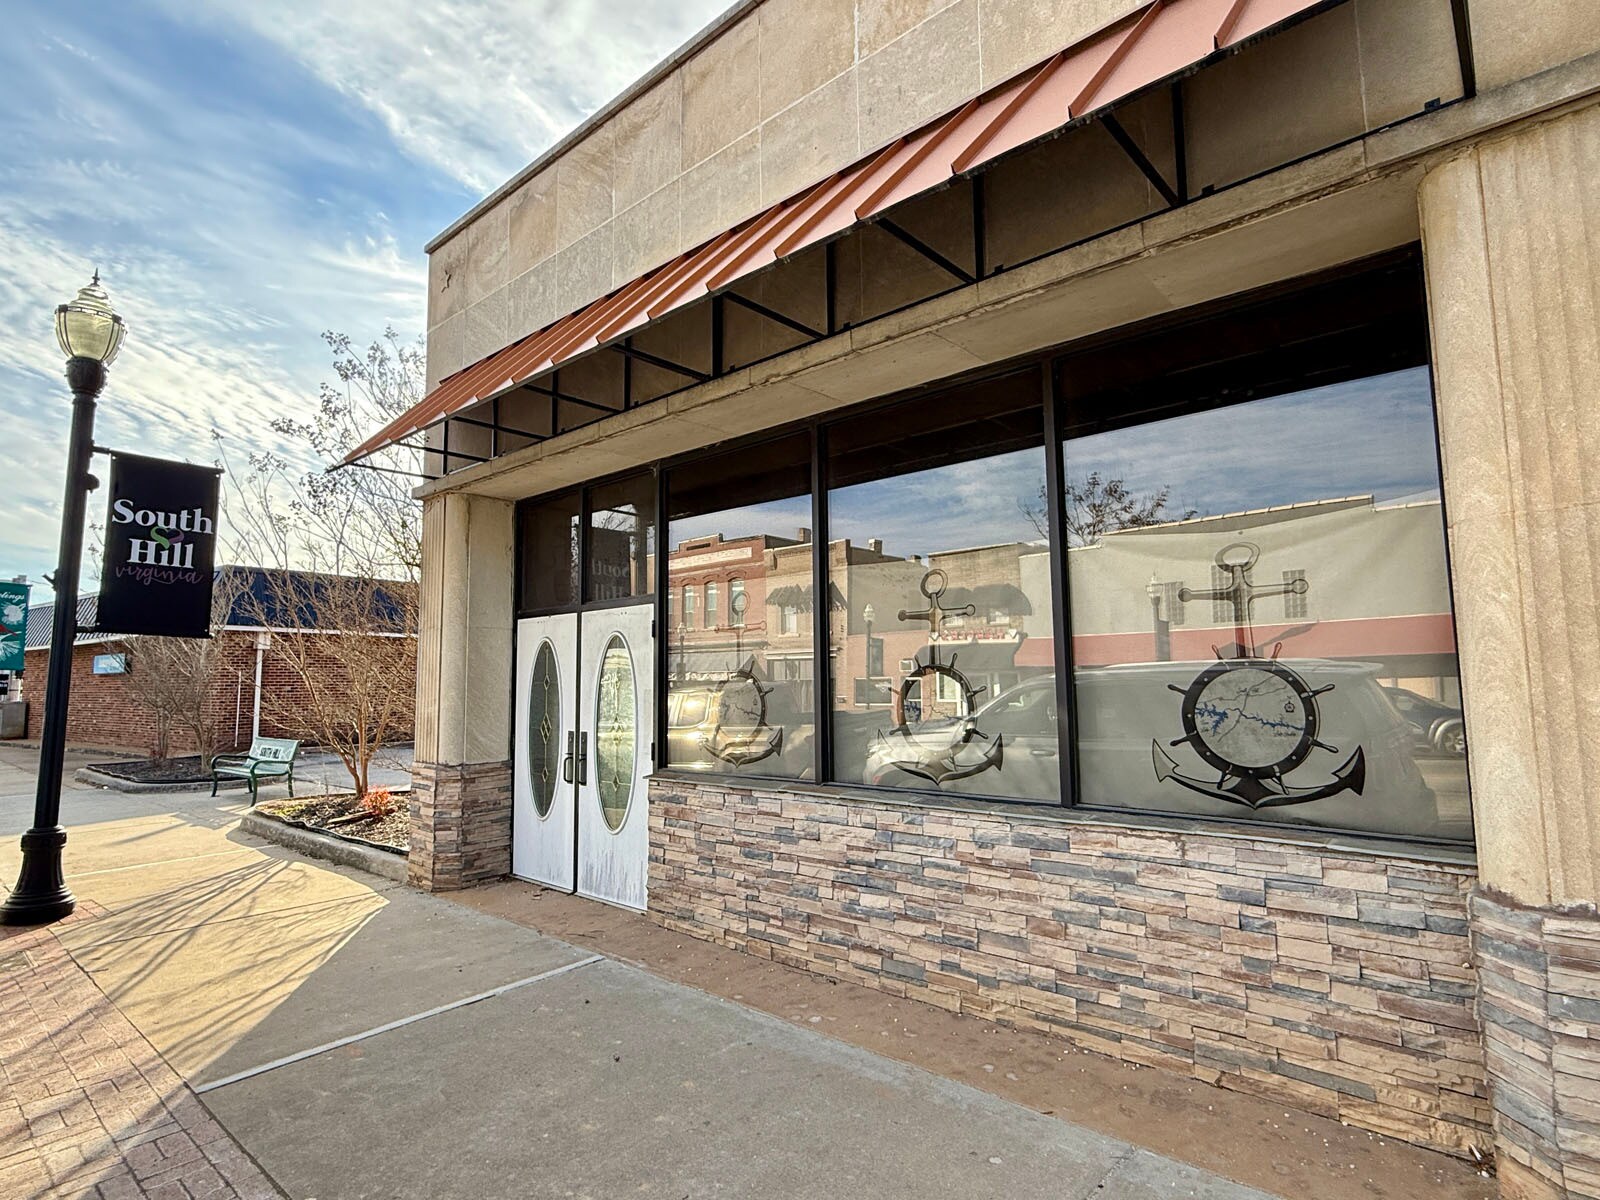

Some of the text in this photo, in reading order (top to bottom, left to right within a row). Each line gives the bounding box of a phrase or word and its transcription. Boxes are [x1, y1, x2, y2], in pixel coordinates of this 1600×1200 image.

[111, 499, 214, 534] South
[127, 538, 195, 569] Hill
[116, 565, 204, 586] virginia
[0, 591, 25, 603] tings
